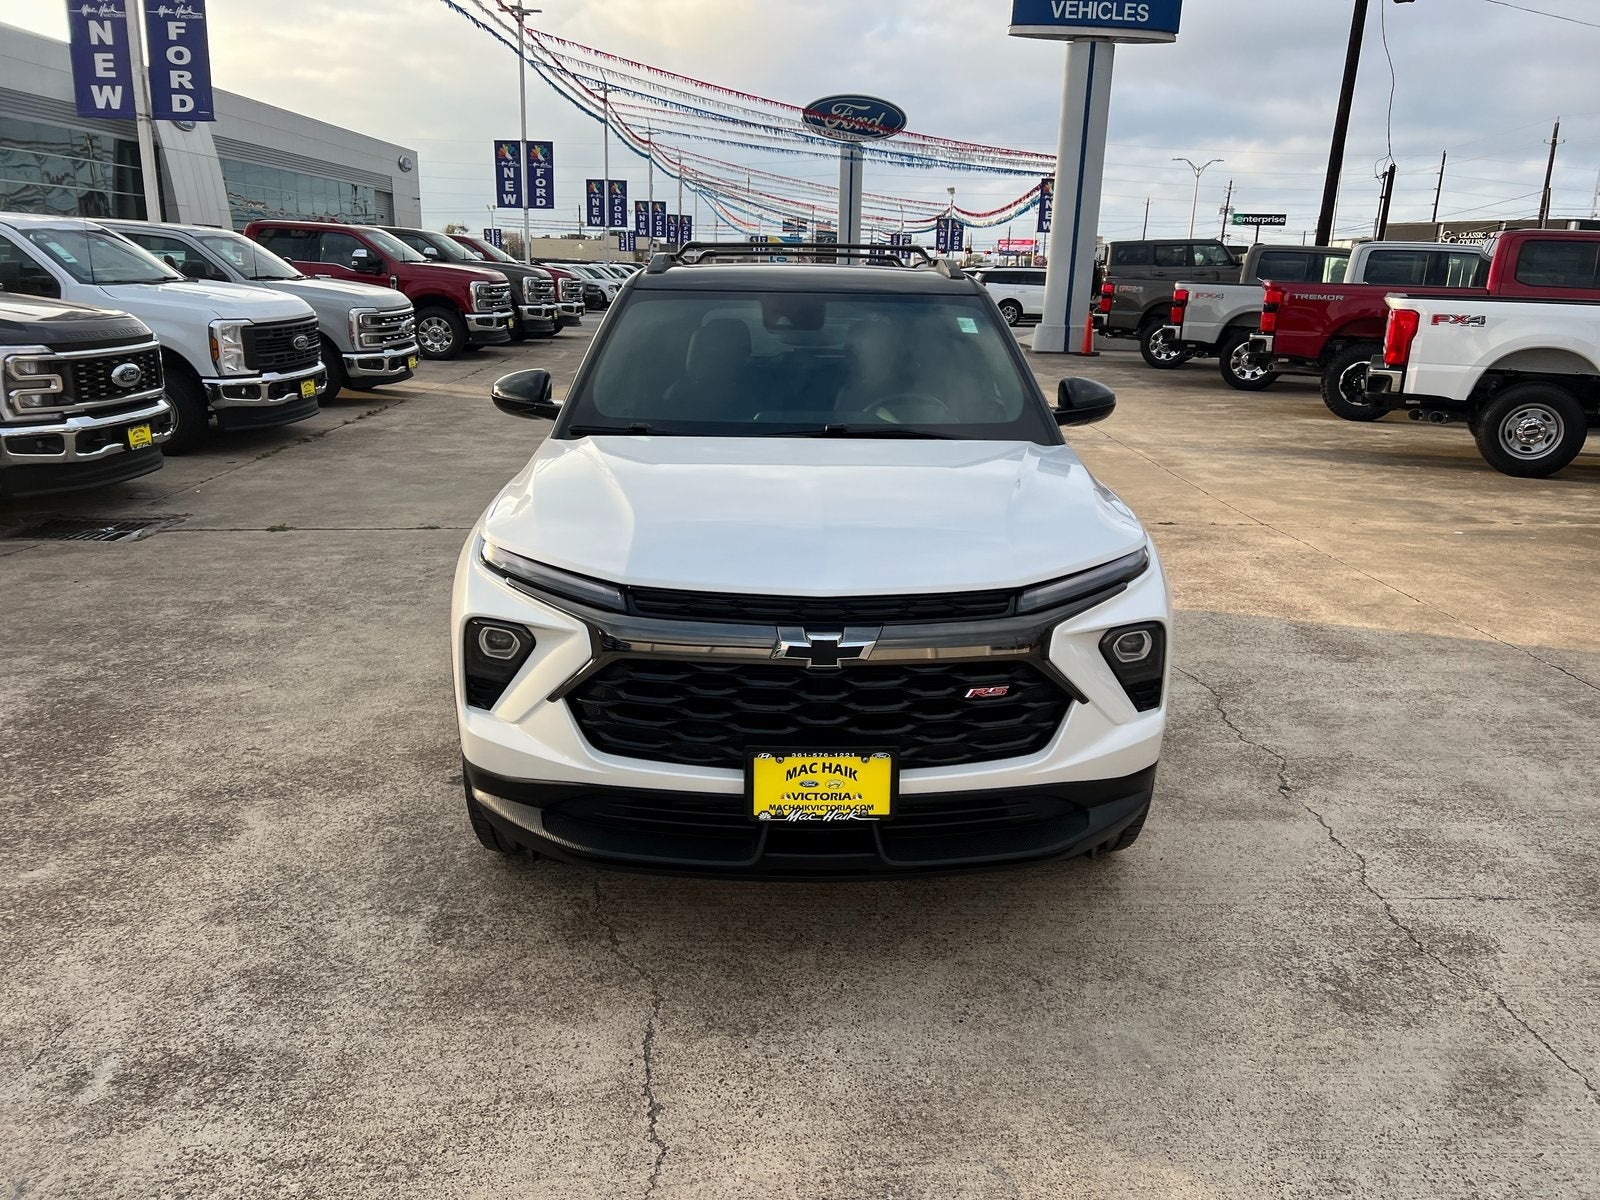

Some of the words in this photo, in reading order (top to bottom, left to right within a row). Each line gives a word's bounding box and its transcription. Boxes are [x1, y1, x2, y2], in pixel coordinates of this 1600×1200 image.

[1051, 1, 1149, 22] VEHICLES
[88, 20, 122, 109] NEW
[166, 21, 194, 112] FORD
[824, 102, 887, 134] Ford
[502, 167, 517, 205] NEW
[535, 168, 546, 206] FORD
[591, 198, 601, 225] NEW
[613, 199, 622, 226] FORD
[1234, 216, 1286, 224] enterprise
[638, 215, 647, 236] NEW
[1458, 231, 1487, 239] CLASSIC
[938, 231, 946, 249] NEW
[1194, 292, 1225, 300] FX4
[1293, 293, 1345, 301] TREMOR
[1431, 314, 1486, 325] FX4
[964, 686, 1010, 699] RS
[786, 762, 818, 781] MAC
[821, 762, 858, 781] HAIK
[791, 792, 852, 801] VICTORIA
[785, 809, 816, 821] Mac
[822, 809, 860, 822] Haik
